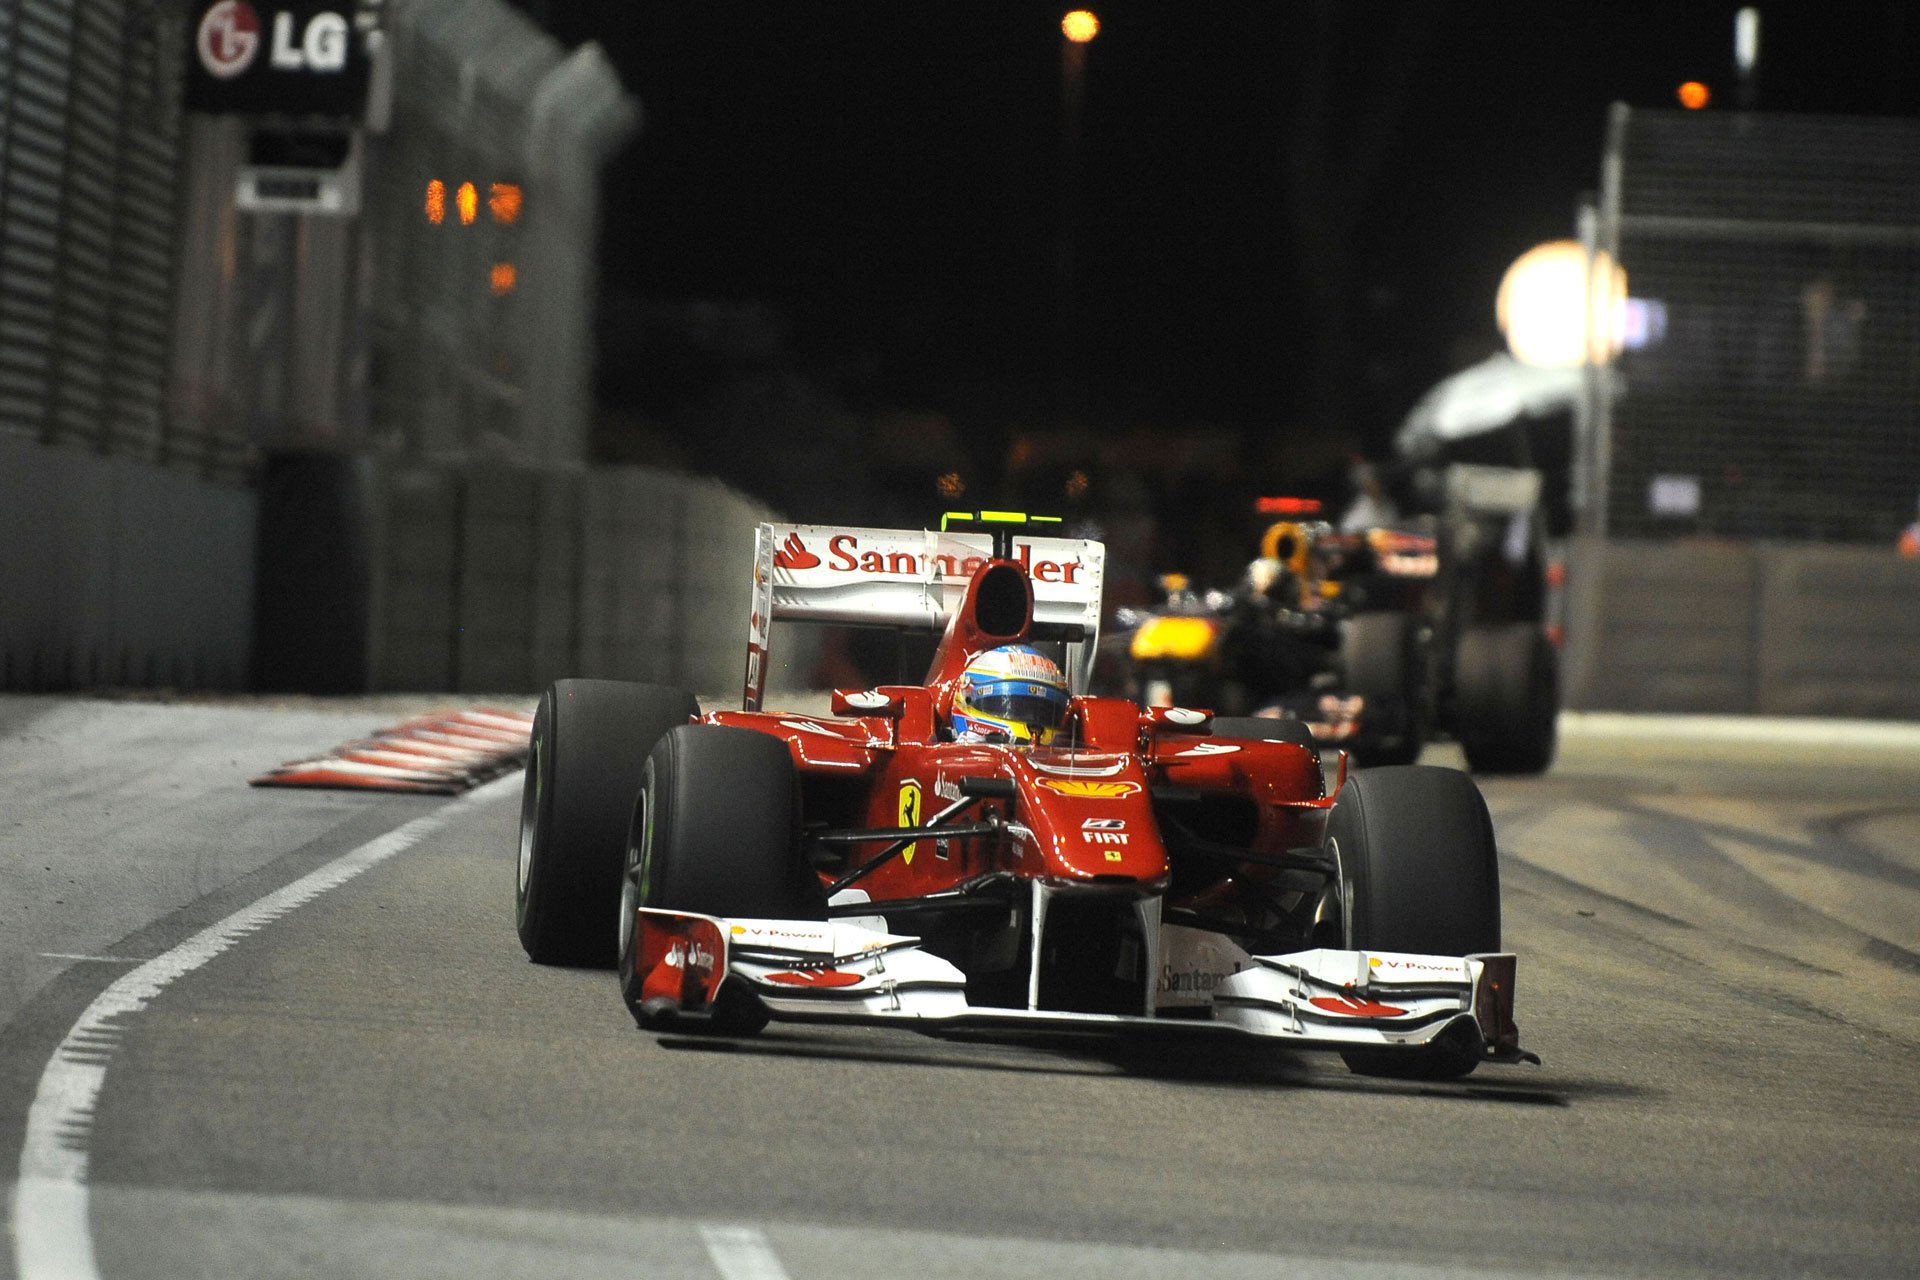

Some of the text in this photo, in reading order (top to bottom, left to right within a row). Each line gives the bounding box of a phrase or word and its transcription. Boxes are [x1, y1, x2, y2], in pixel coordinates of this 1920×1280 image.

[271, 11, 348, 69] LG
[1082, 831, 1129, 845] FIAT
[749, 928, 823, 939] V-Power
[1387, 961, 1461, 972] V-Power
